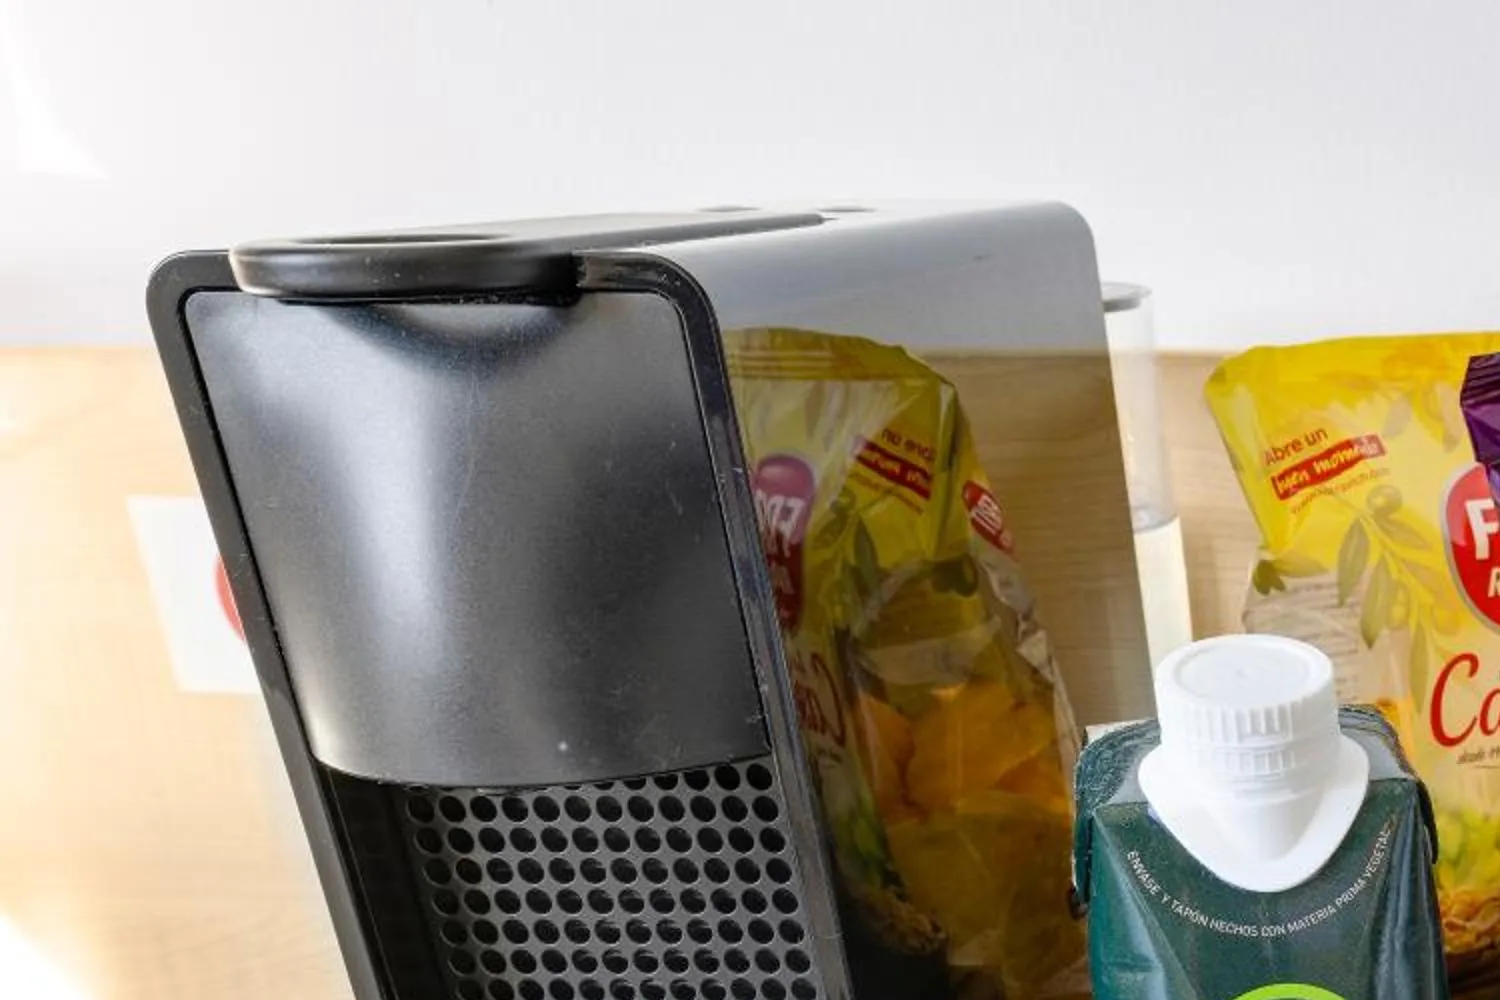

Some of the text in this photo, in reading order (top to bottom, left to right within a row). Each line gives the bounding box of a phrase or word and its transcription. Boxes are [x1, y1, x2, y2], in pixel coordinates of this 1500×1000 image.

[1304, 428, 1328, 446] un
[1209, 918, 1259, 937] HECHOS
[1261, 925, 1287, 937] CON
[1286, 904, 1337, 934] MATERIA
[1335, 878, 1367, 909] PRIMA
